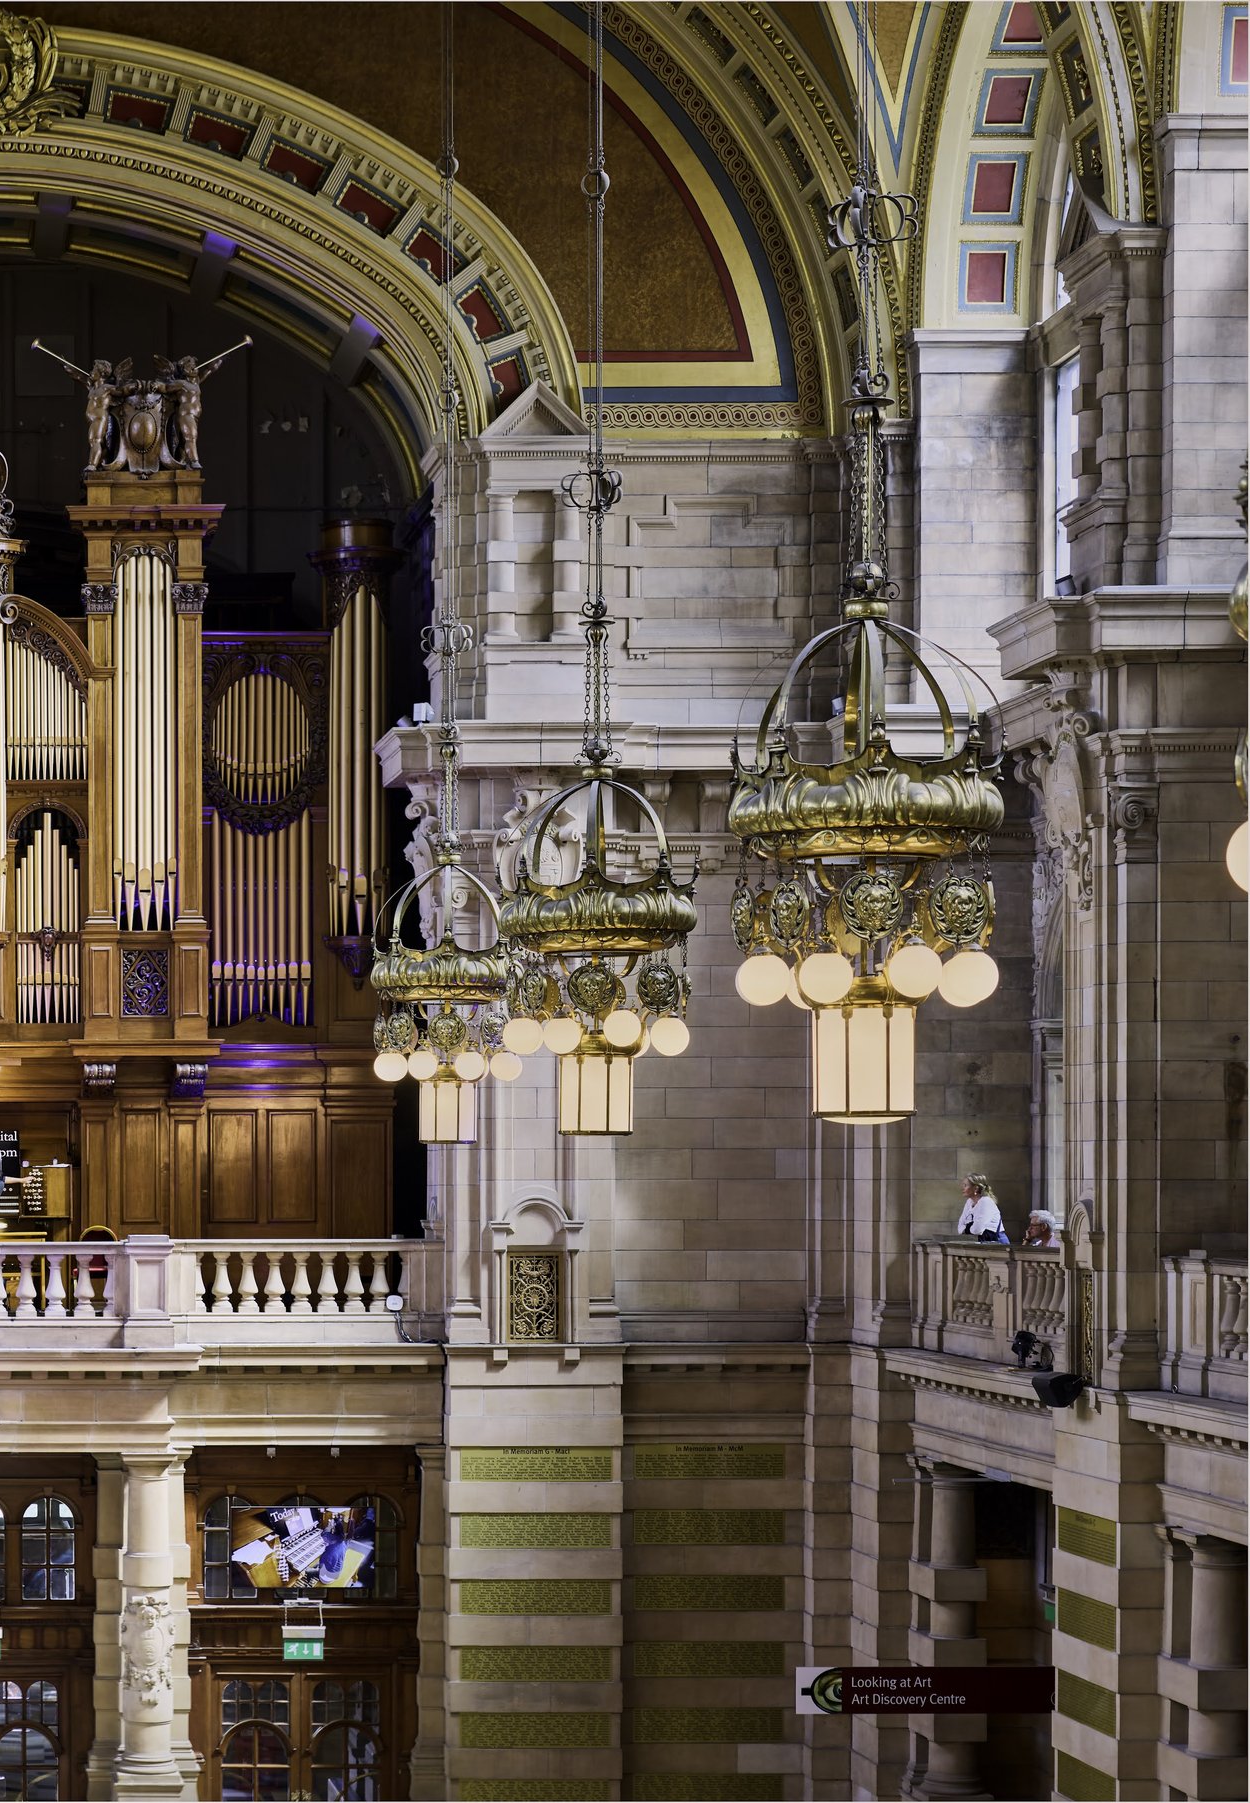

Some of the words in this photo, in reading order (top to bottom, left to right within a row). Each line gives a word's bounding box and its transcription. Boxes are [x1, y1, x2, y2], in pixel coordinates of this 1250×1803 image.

[270, 1508, 295, 1522] Today
[851, 1676, 897, 1690] Looking
[900, 1677, 911, 1688] at
[913, 1676, 931, 1688] Art
[851, 1694, 870, 1705] Art
[872, 1693, 927, 1707] Discovery
[929, 1694, 966, 1705] Centre
